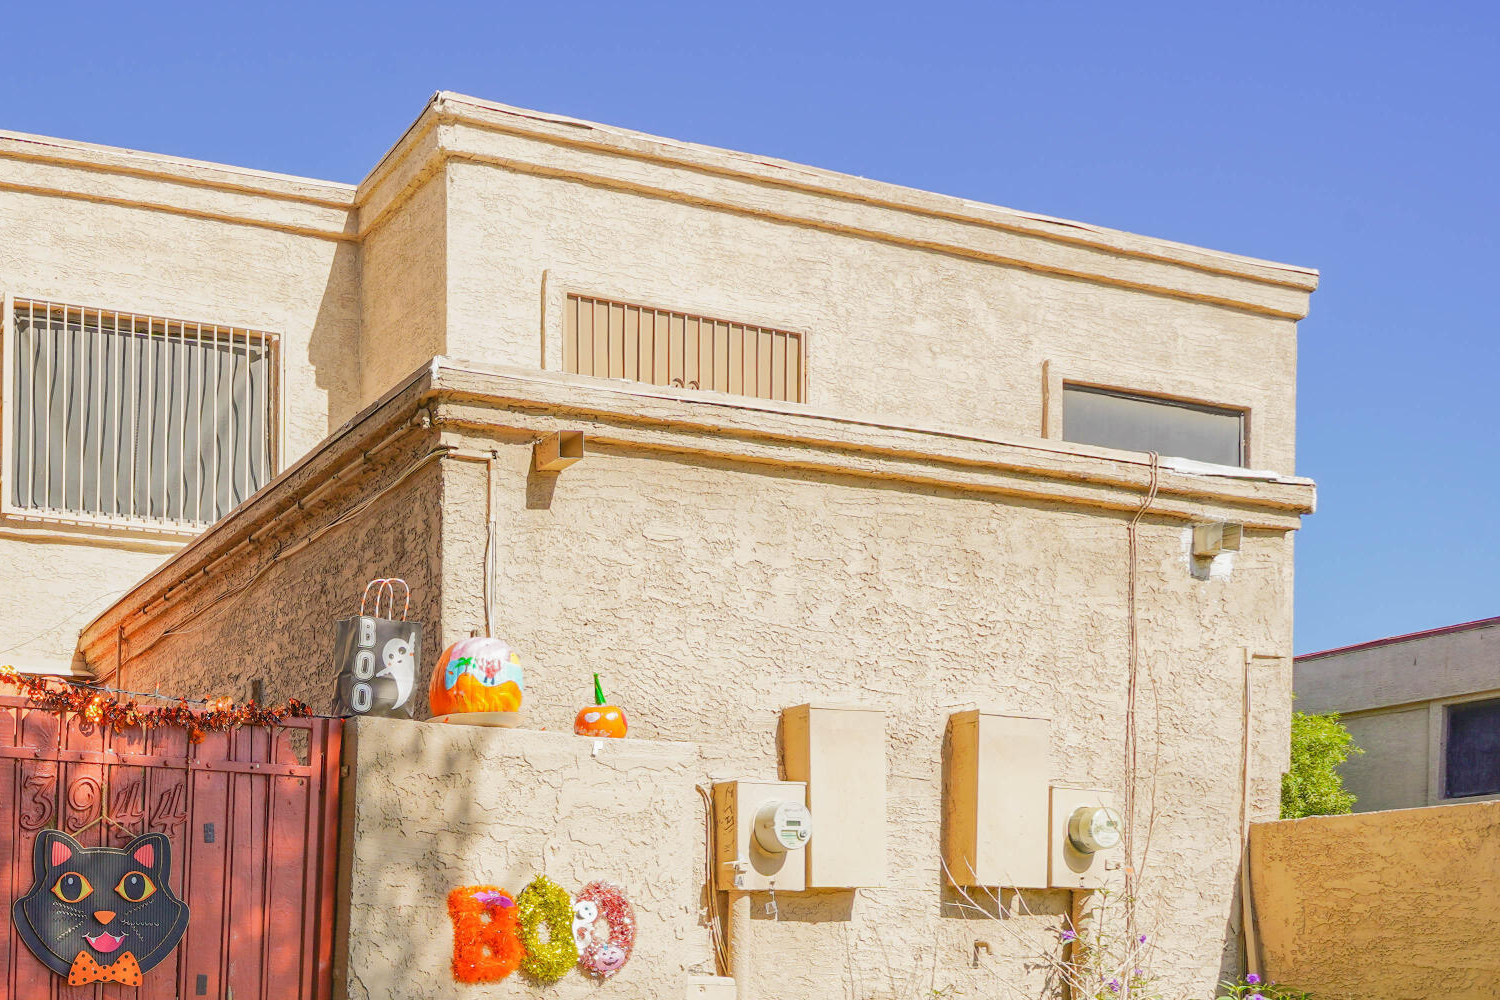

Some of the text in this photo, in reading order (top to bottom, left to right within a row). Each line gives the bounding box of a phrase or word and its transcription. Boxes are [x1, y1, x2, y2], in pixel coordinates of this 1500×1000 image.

[351, 616, 376, 713] BOO
[20, 775, 187, 839] 3944
[446, 873, 636, 985] BOO
